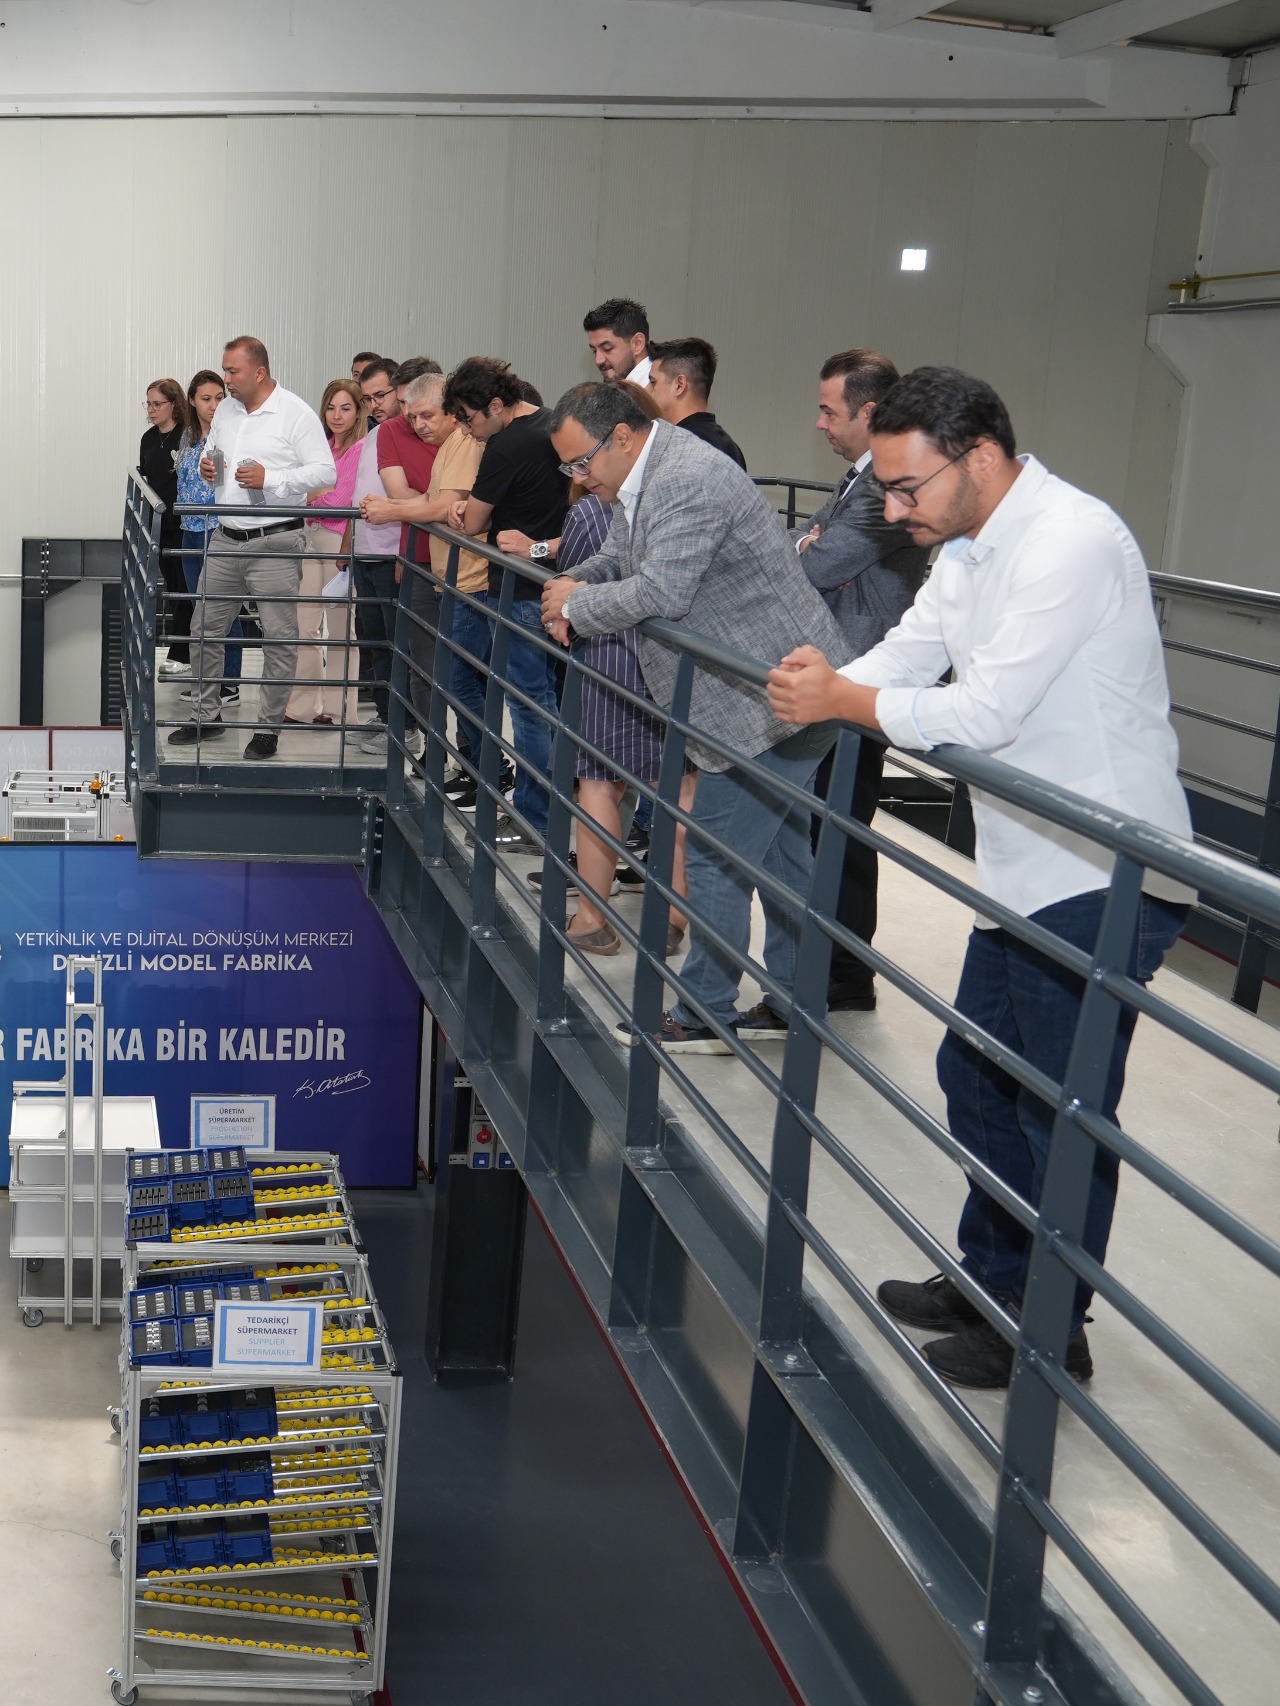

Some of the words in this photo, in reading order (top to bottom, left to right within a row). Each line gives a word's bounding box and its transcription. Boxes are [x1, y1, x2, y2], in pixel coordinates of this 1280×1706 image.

[15, 930, 96, 946] YETKİNLİK
[100, 932, 122, 946] VE
[127, 930, 188, 946] DİJİTAL
[192, 930, 279, 950] DÖNÜŞÜM
[284, 930, 353, 946] MERKEZİ
[140, 954, 217, 971] MODEL
[223, 950, 313, 971] FABRİKA
[16, 1027, 146, 1061] FABRKA
[156, 1019, 208, 1061] BİR
[218, 1019, 346, 1061] KALEDİR
[219, 1107, 245, 1115] ÜRETİM
[246, 1316, 290, 1325] TEDARİKÇİ
[237, 1326, 298, 1335] SÜPERMARKET
[237, 1348, 297, 1356] SUPERMARKET
